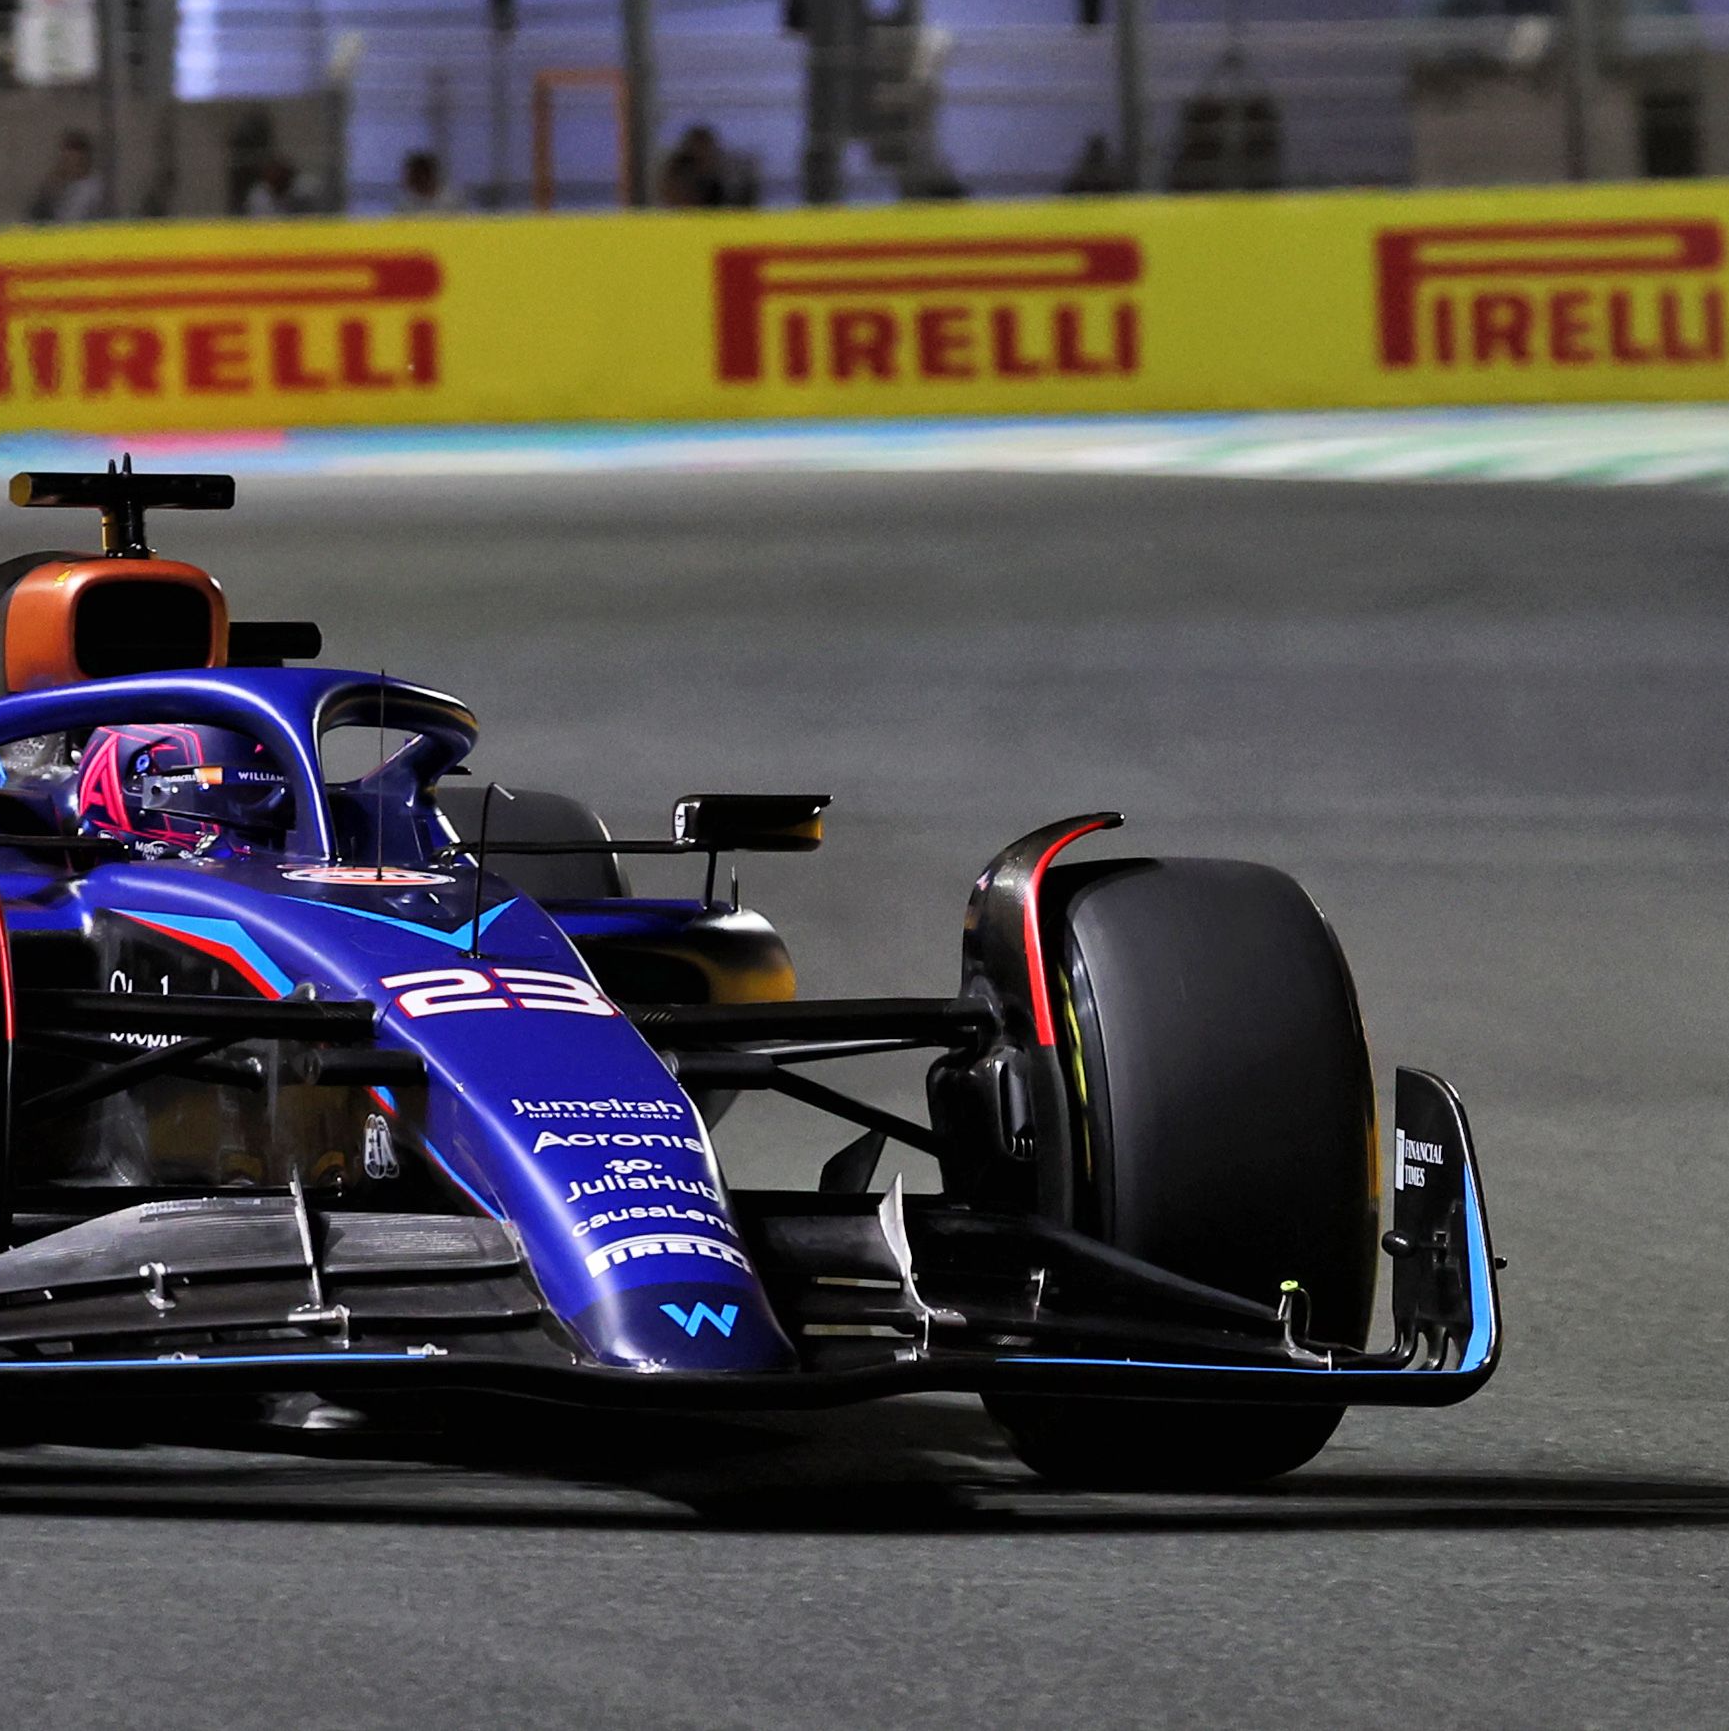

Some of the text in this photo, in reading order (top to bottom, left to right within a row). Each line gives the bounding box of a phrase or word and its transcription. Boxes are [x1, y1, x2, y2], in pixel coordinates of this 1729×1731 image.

[1377, 217, 1727, 367] PIRELLI
[715, 235, 1142, 384] PIRELLI
[379, 967, 620, 1020] 23
[511, 1098, 685, 1116] Jumeirah
[528, 1112, 590, 1120] HOTELS
[610, 1112, 681, 1120] RESORTS
[533, 1130, 705, 1154] Acronis
[1405, 1138, 1443, 1164] FINANCIAL
[566, 1174, 719, 1204] JuliaHub
[1405, 1164, 1425, 1187] TIMES
[571, 1204, 739, 1239] causaLens
